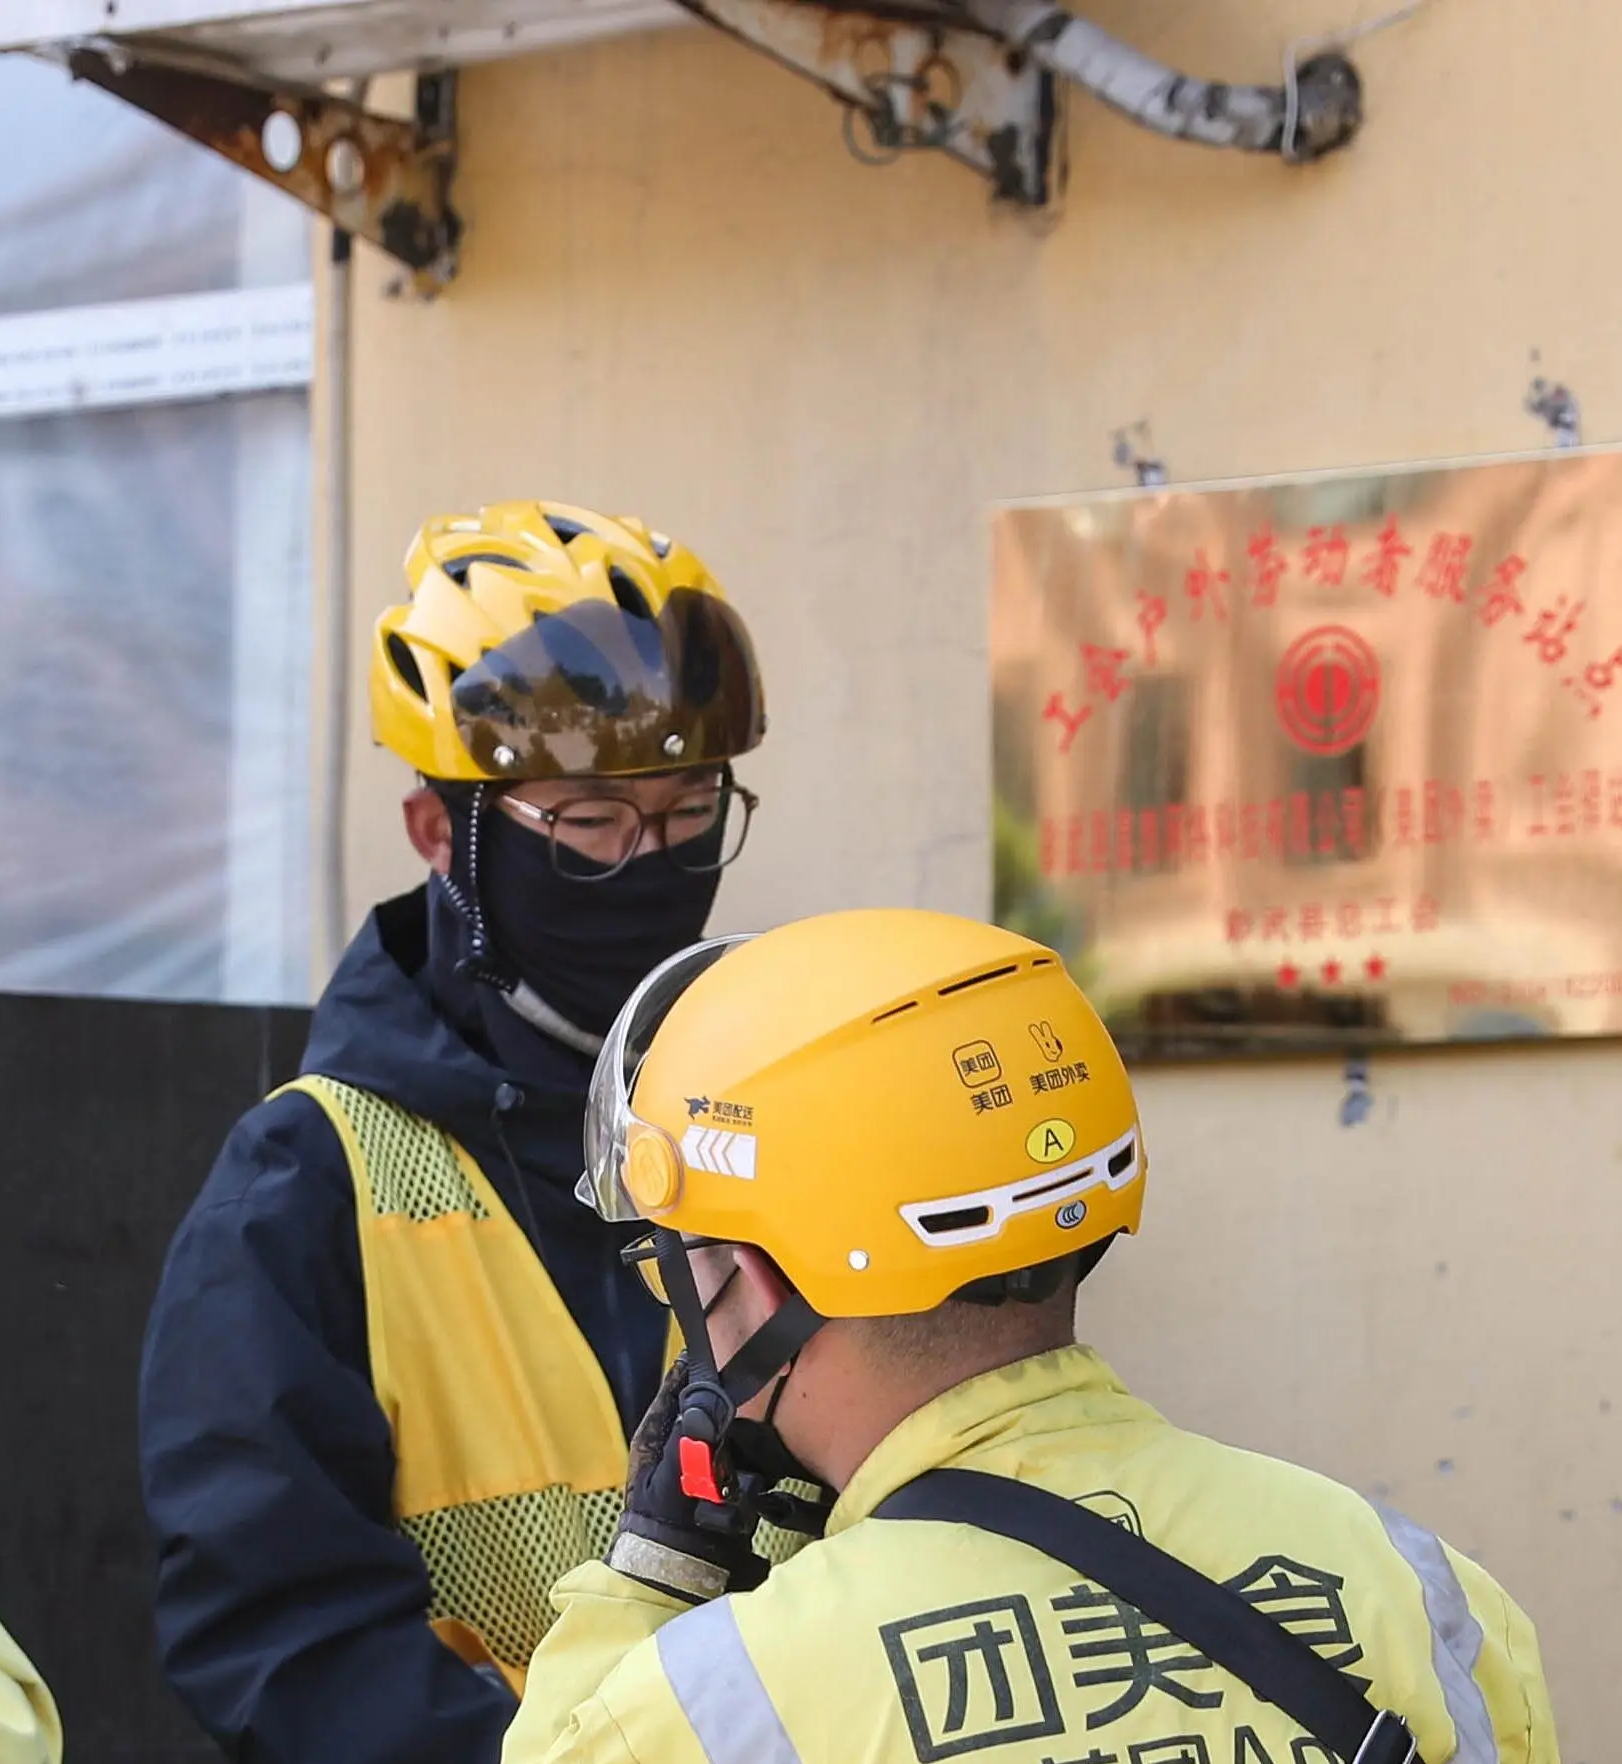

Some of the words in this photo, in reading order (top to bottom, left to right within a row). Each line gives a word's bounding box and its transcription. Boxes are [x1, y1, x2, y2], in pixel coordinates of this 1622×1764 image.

[960, 1052, 995, 1076] 美团
[1030, 1062, 1091, 1095] 美团外卖
[969, 1083, 1013, 1116] 美团
[1043, 1127, 1065, 1157] A
